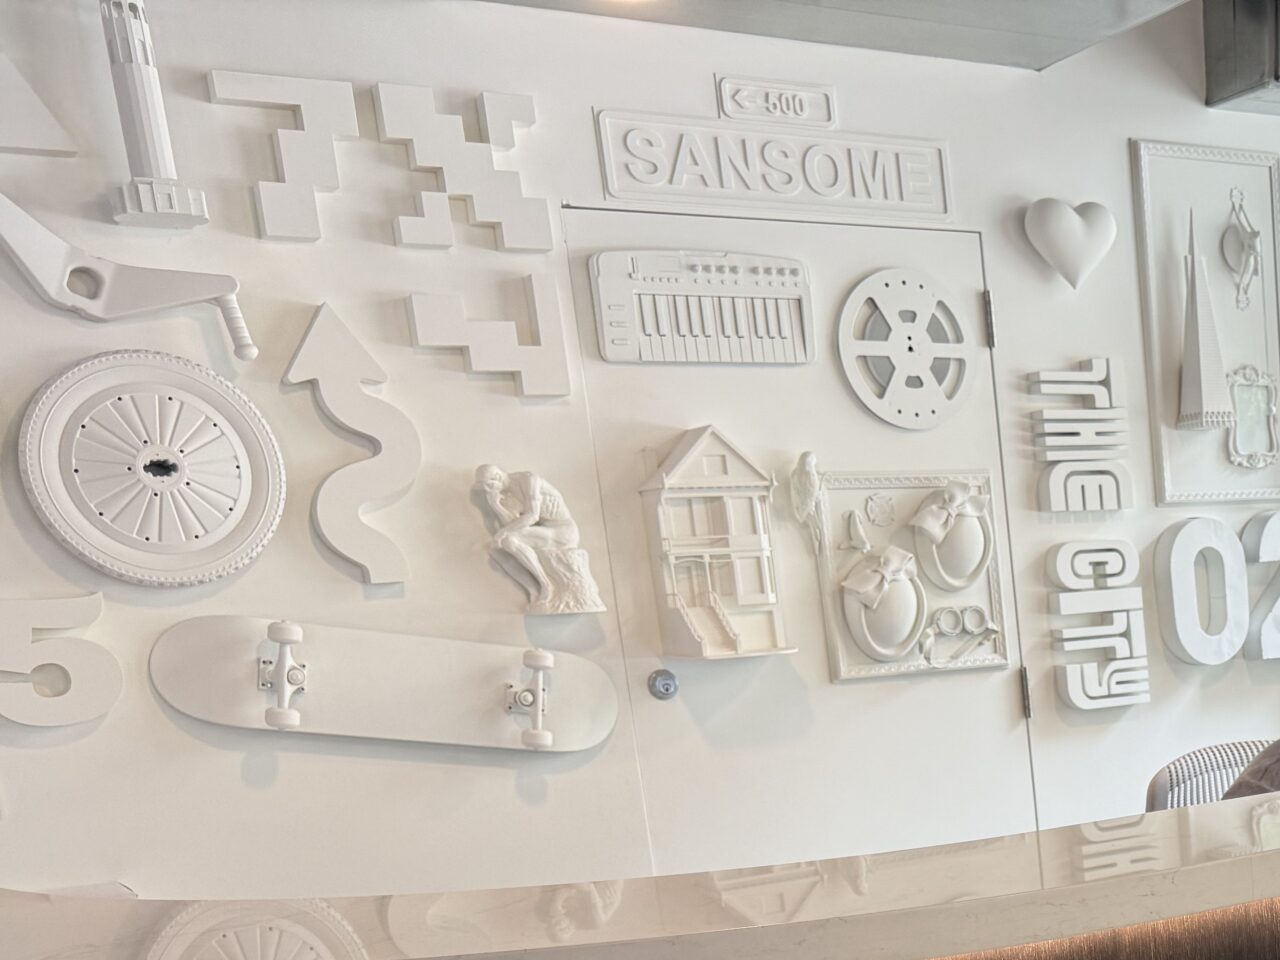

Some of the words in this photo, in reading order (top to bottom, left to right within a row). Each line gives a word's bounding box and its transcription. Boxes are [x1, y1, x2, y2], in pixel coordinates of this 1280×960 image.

[763, 91, 809, 118] 500
[623, 127, 936, 207] SANSOME
[1028, 357, 1133, 514] THE
[1045, 538, 1151, 711] CITY
